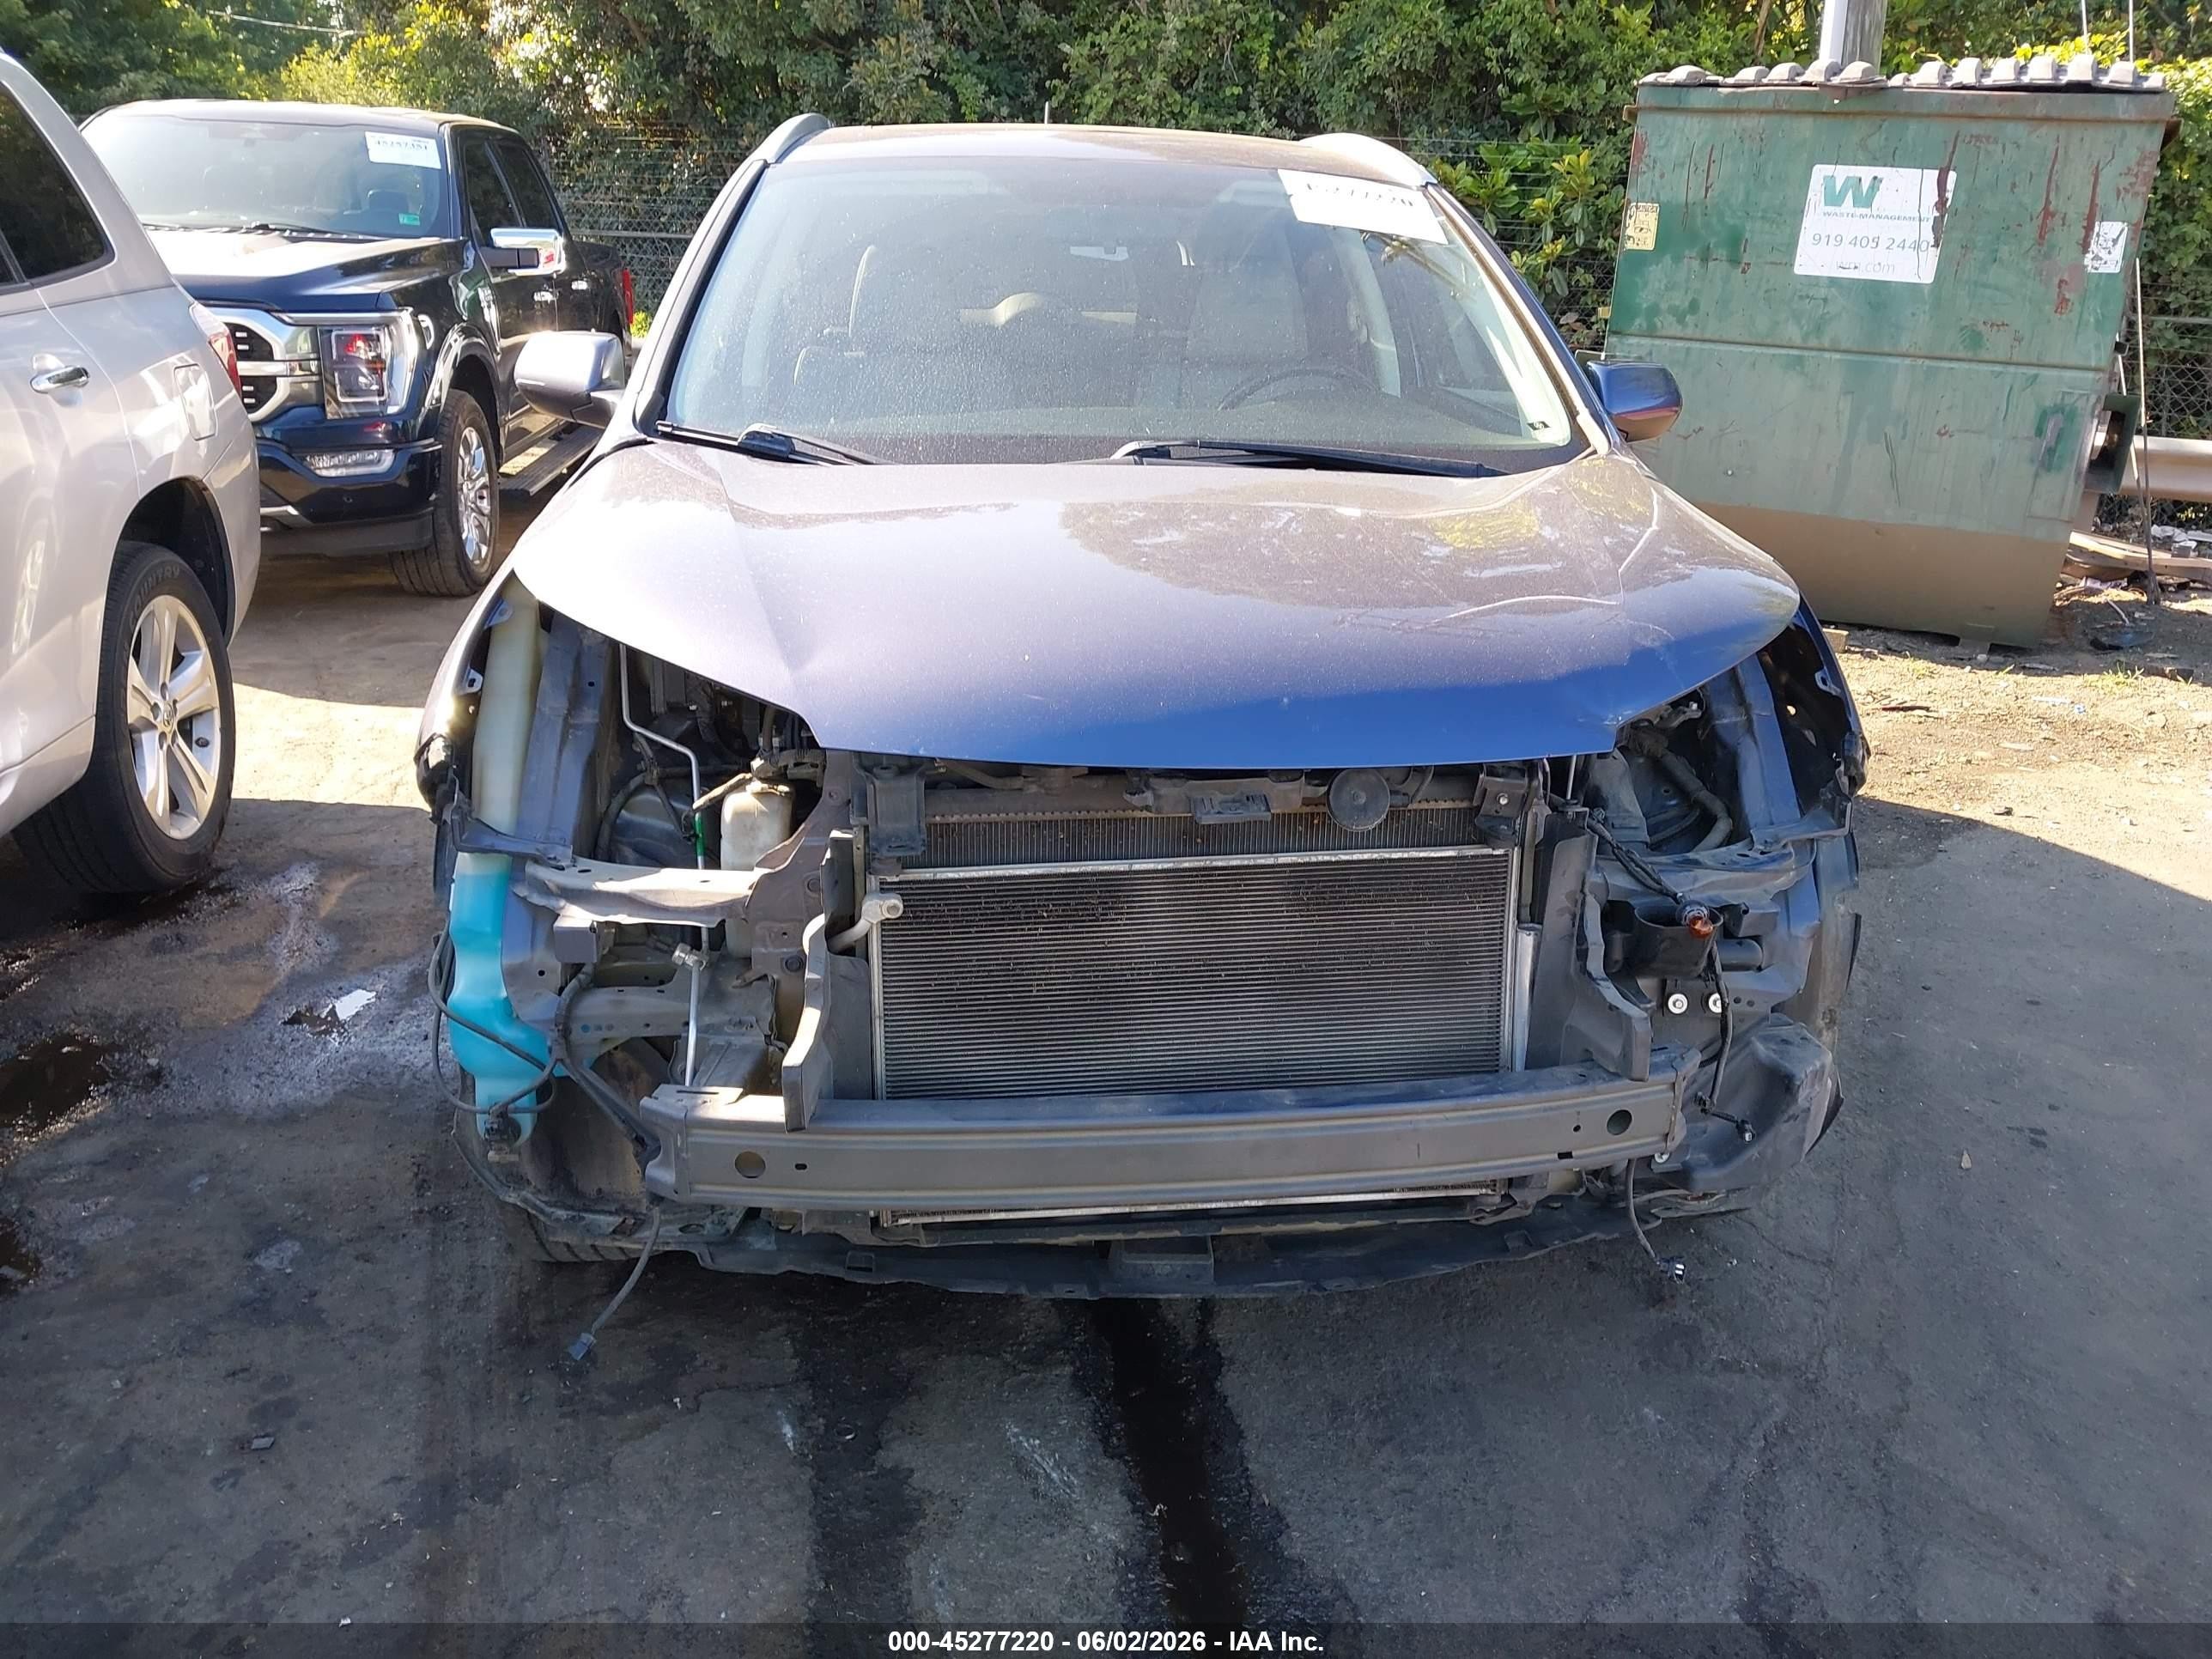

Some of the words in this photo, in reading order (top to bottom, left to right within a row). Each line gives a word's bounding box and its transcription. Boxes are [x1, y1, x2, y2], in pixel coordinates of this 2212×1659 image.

[1859, 213, 1931, 223] MANAGEMENT
[1812, 233, 1843, 247] 919
[1849, 235, 1881, 249] 405
[1886, 237, 1930, 253] 2440
[1836, 261, 1896, 275] wm.com
